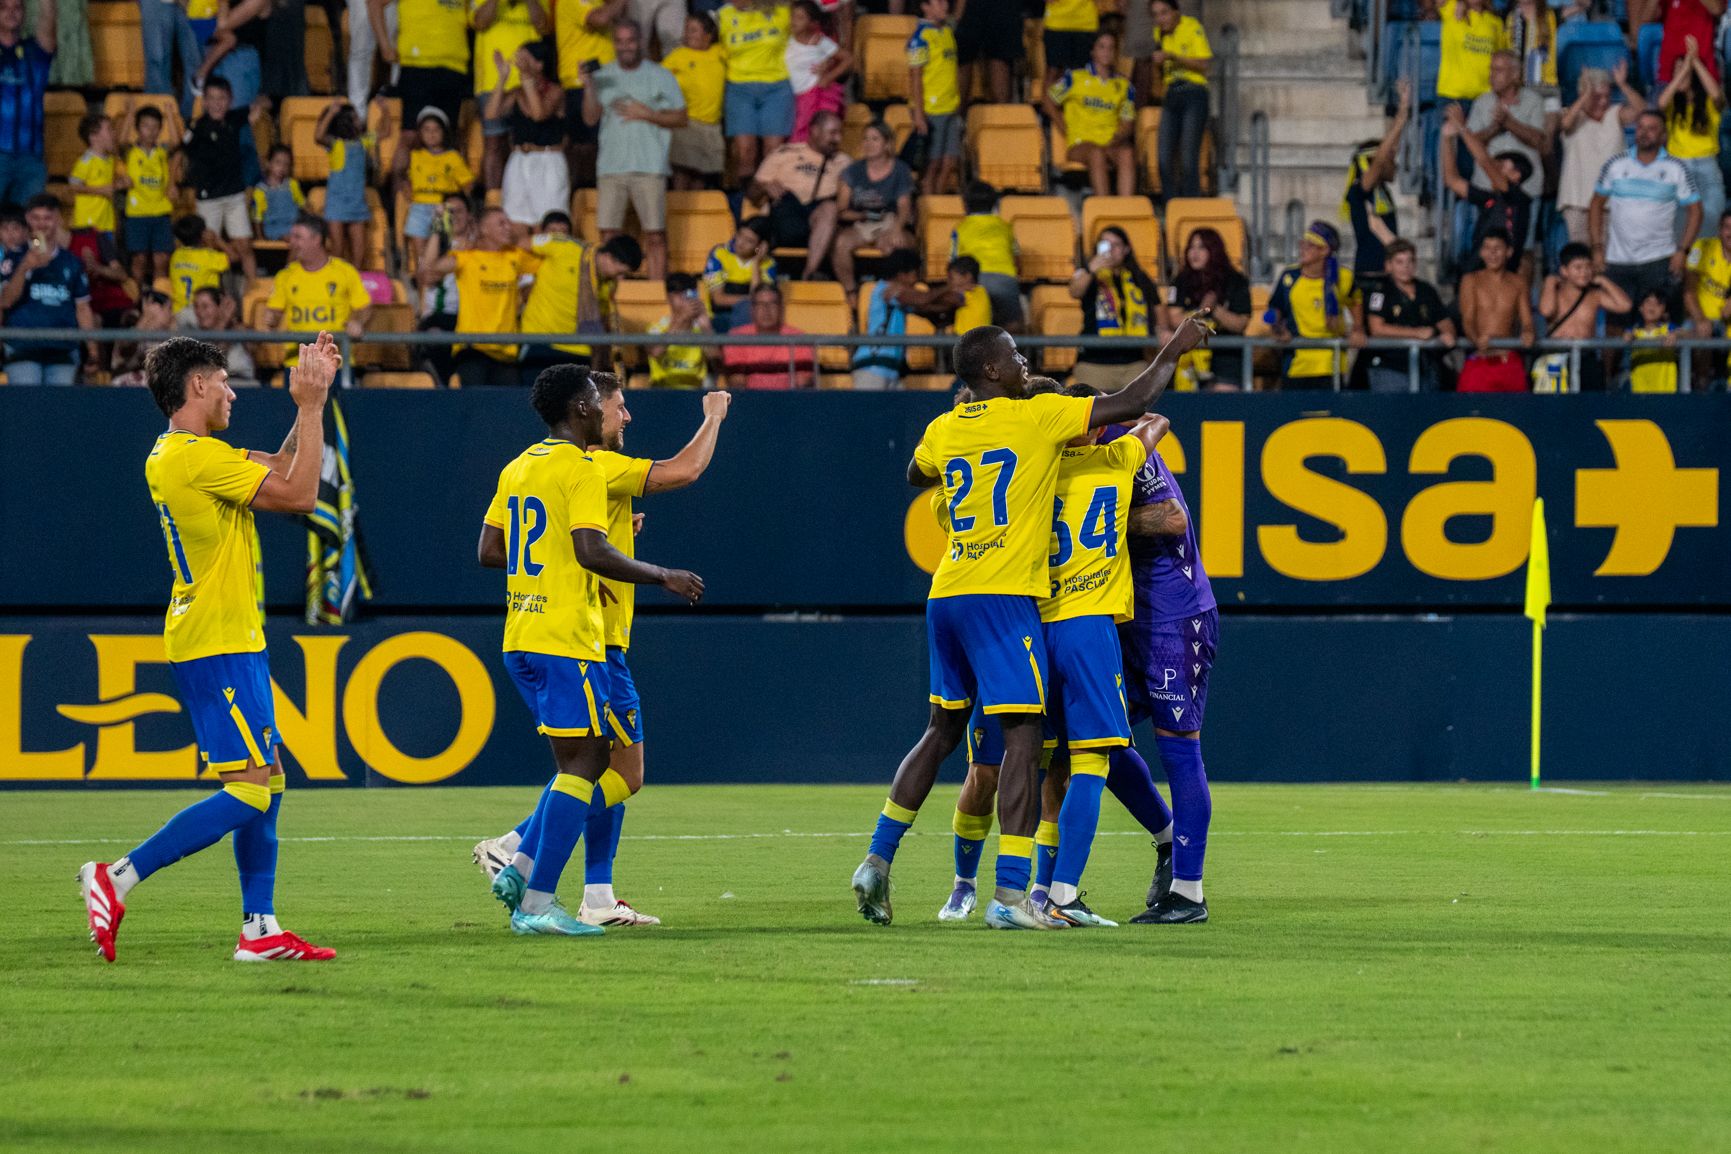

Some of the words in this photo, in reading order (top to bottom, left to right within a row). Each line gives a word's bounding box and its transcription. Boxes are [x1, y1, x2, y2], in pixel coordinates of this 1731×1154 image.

[292, 305, 337, 323] DIGI
[944, 447, 1018, 533] 27
[505, 495, 547, 577] 12
[1064, 568, 1111, 585] Hospitales
[1149, 691, 1186, 702] FINANCIAL
